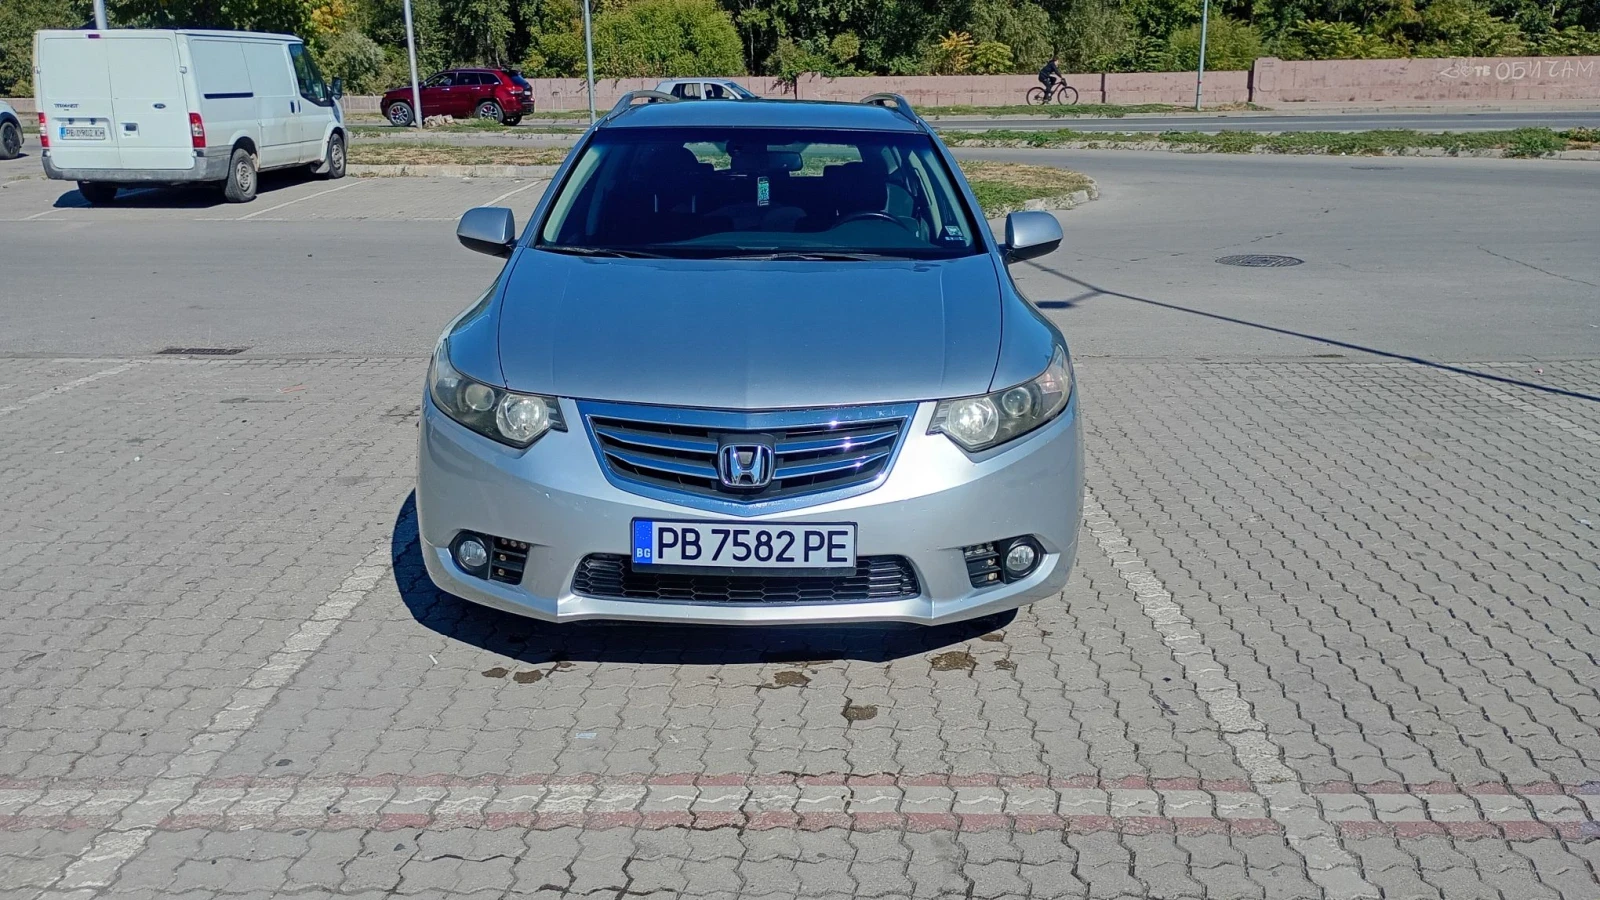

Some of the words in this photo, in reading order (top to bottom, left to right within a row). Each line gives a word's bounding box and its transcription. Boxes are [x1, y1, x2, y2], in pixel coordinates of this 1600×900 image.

[636, 547, 651, 558] BG
[658, 527, 702, 560] PB
[711, 529, 795, 562] 7582
[804, 530, 848, 562] PE
